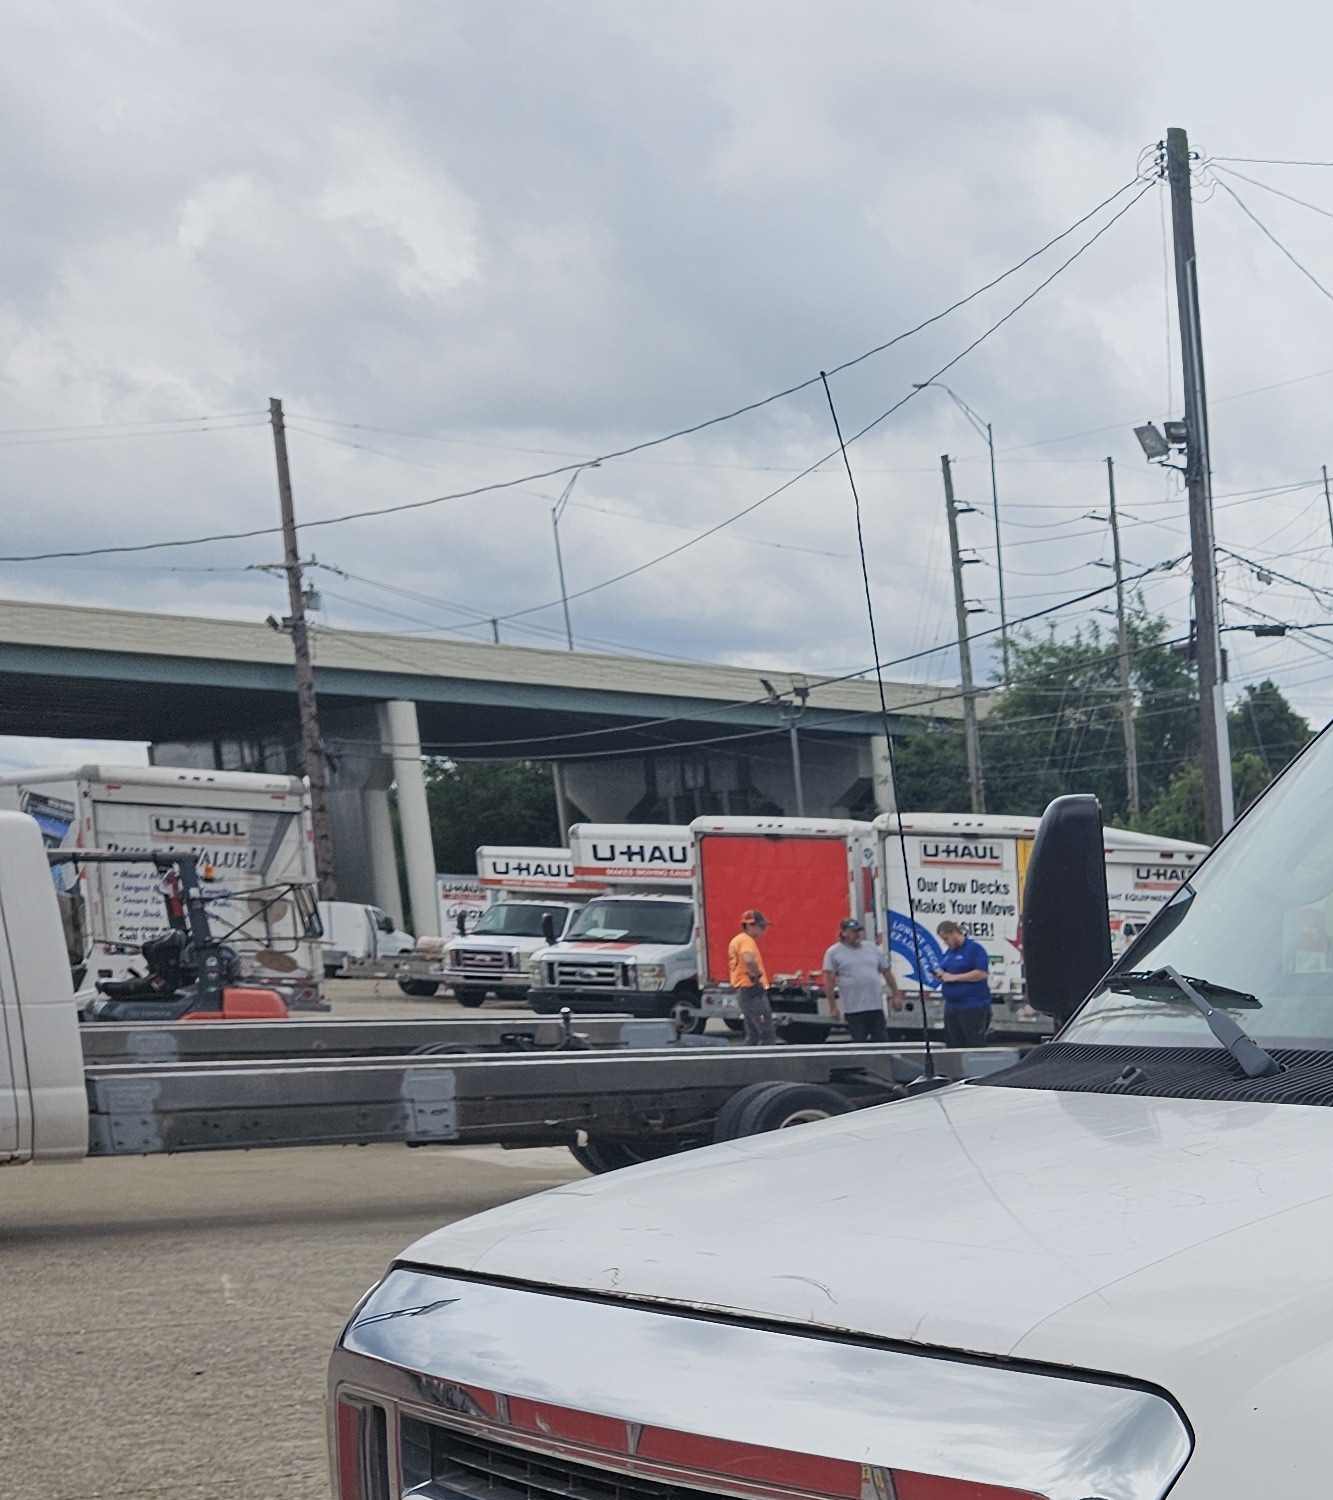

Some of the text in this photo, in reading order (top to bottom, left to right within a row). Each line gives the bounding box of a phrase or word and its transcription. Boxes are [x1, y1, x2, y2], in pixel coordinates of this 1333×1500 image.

[155, 818, 246, 836] U-HAUL
[592, 844, 688, 863] U-HAU
[923, 844, 1000, 859] U-HAUL
[493, 861, 574, 878] U-HAUL
[1136, 868, 1192, 881] U-HAU
[917, 877, 1010, 895] Our Low Decks
[911, 898, 1015, 916] Make Your Move
